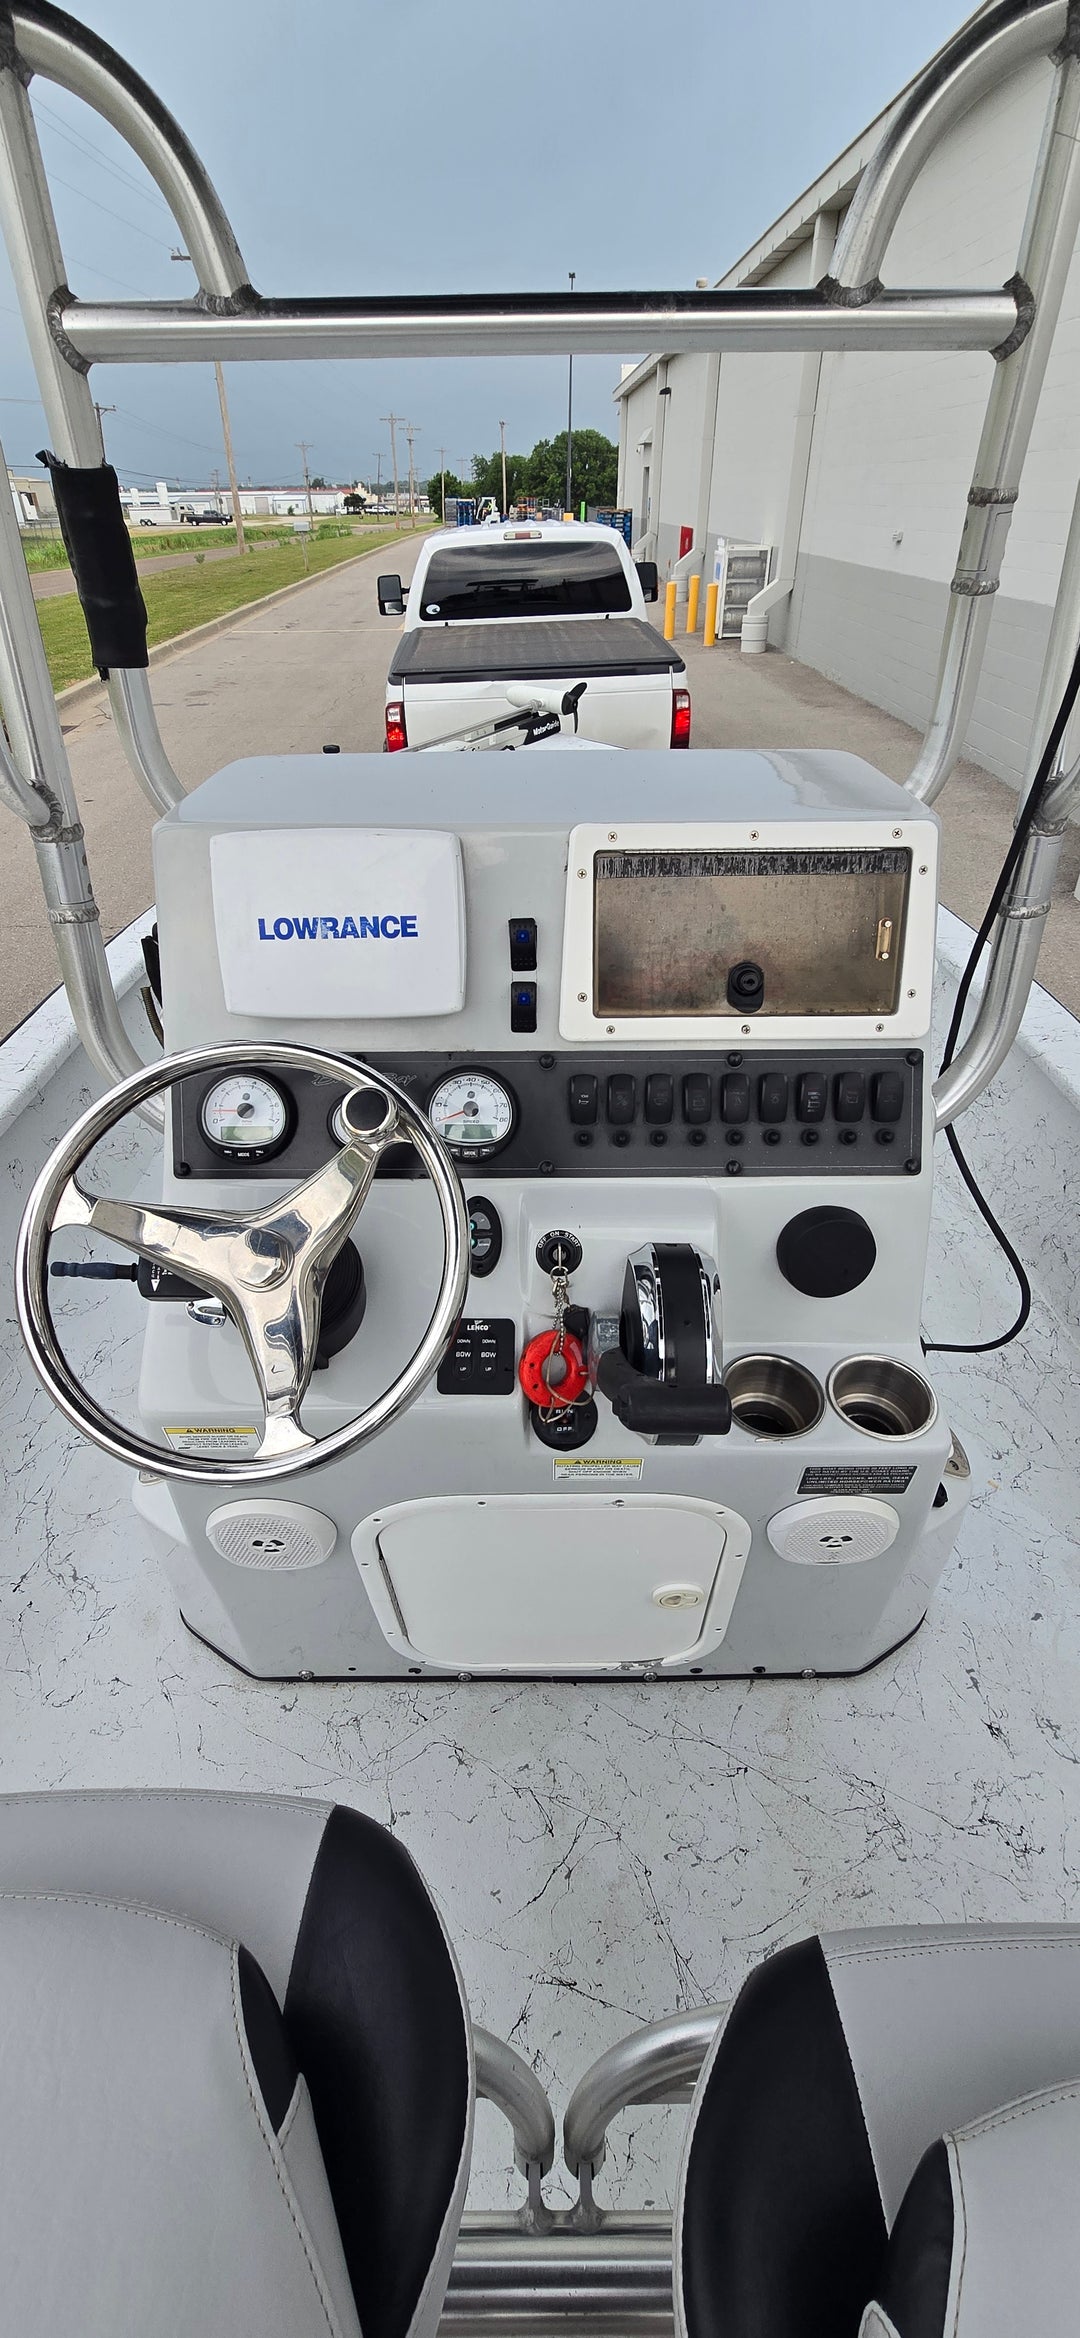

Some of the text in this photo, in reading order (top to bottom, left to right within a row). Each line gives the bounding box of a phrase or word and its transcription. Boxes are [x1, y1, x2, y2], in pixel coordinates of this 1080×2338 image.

[258, 916, 418, 940] LOWRANCE
[538, 1236, 546, 1248] OFF
[564, 1232, 580, 1247] START
